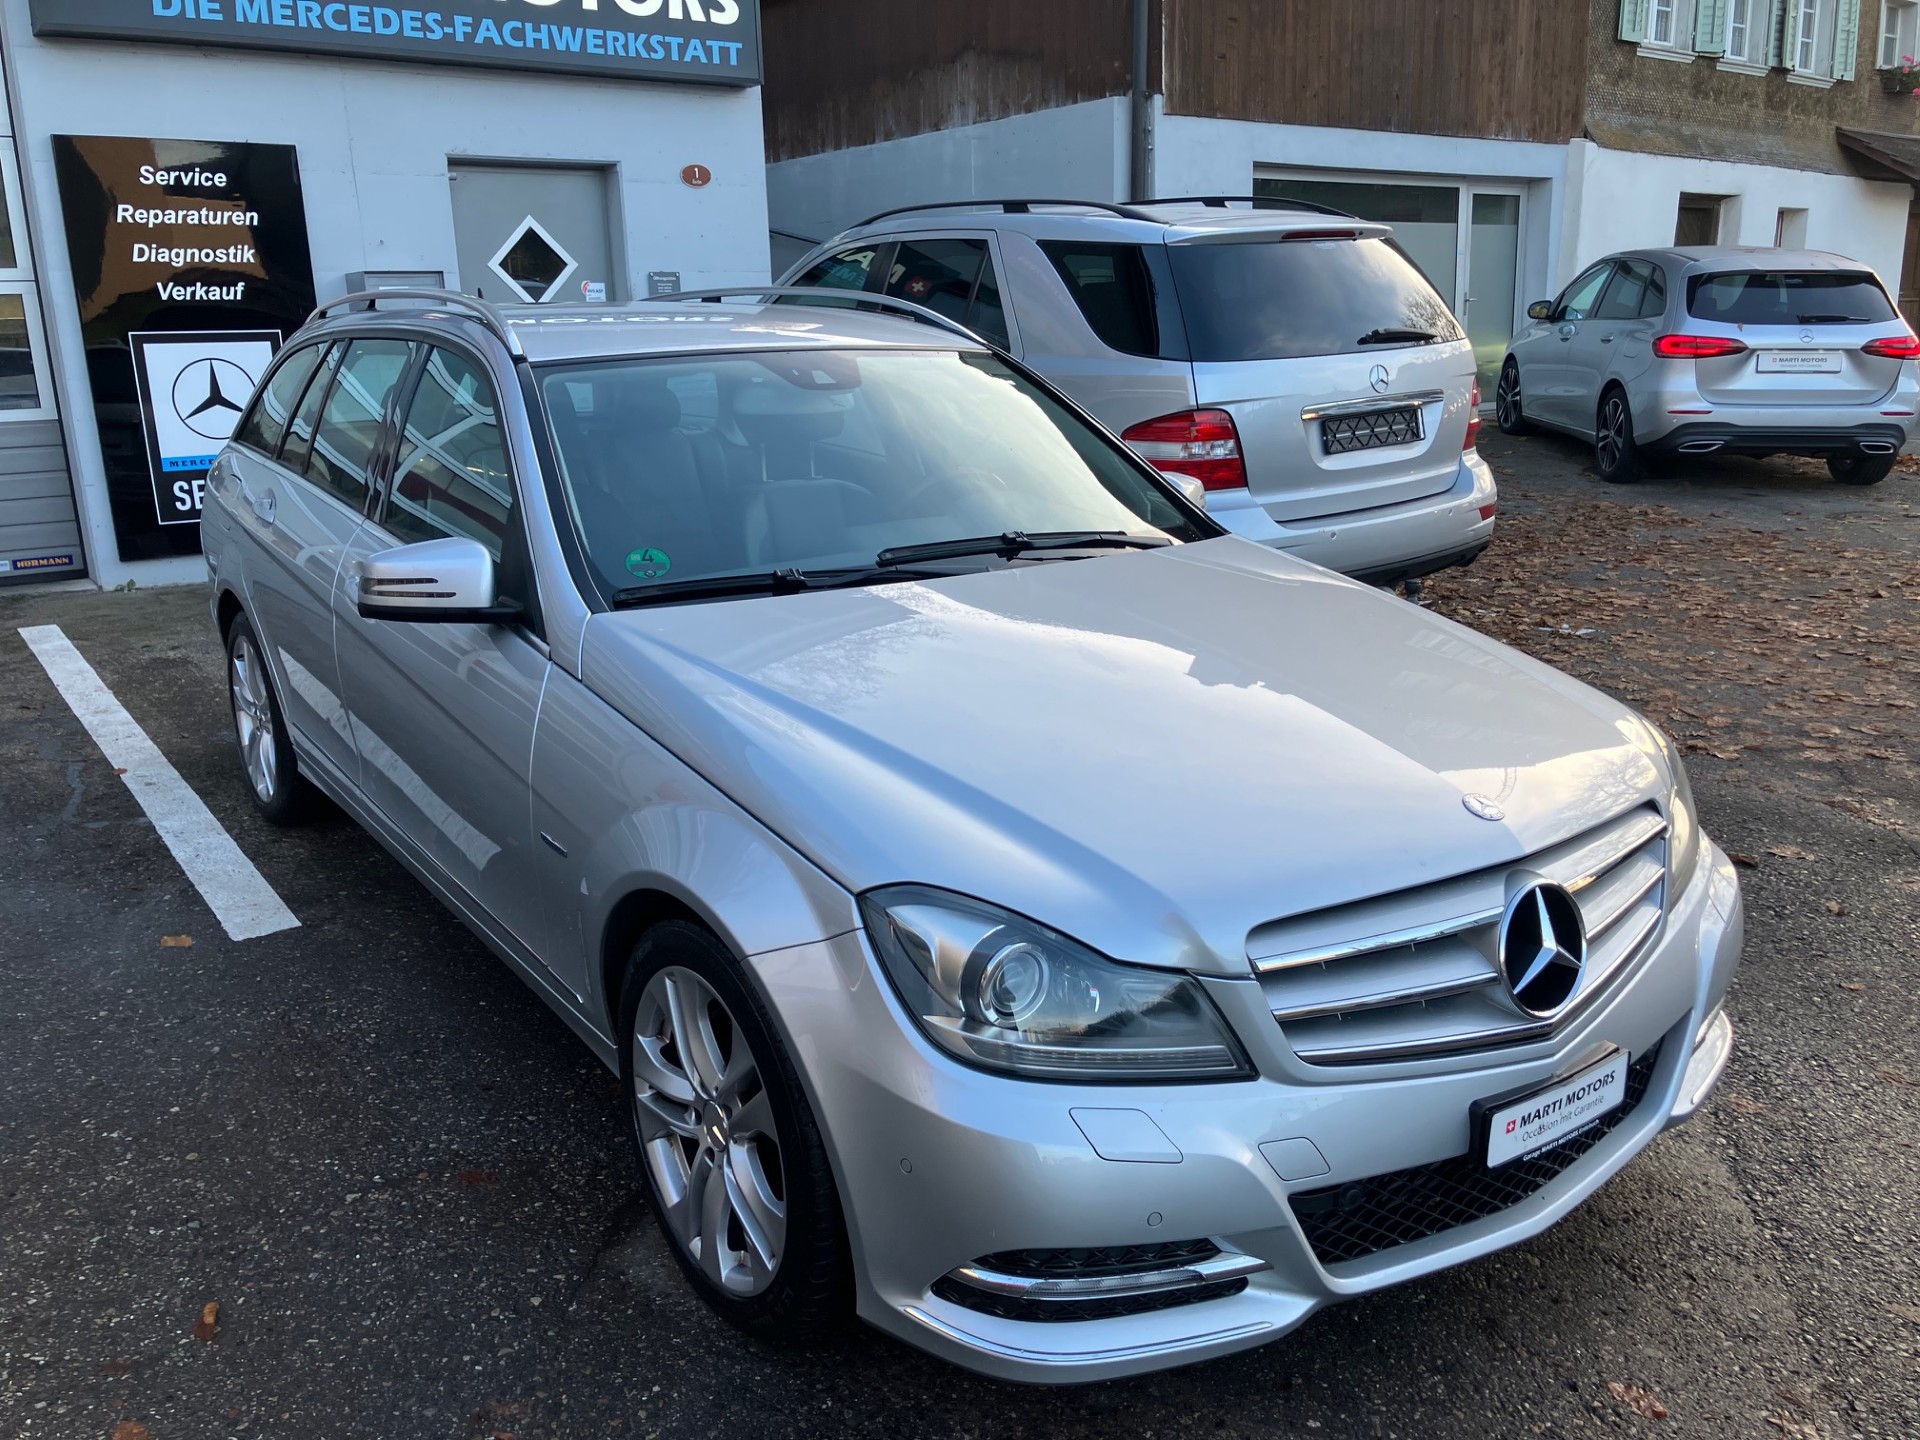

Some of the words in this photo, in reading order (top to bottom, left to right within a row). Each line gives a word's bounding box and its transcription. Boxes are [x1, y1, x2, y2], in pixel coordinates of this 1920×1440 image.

[153, 0, 224, 21] DIE
[235, 0, 743, 66] MERCEDES-FACHWERKSTATT
[139, 165, 228, 187] Service
[694, 167, 699, 178] 1
[116, 204, 259, 228] Reparaturen
[132, 243, 256, 267] Diagnostik
[157, 281, 246, 300] Verkauf
[169, 458, 215, 467] MERCE
[173, 479, 206, 511] SE
[641, 549, 655, 563] 4
[1519, 1098, 1563, 1128] MARTI
[1564, 1070, 1616, 1107] MOTORS
[1522, 1119, 1559, 1141] Occasion
[1559, 1111, 1573, 1126] mit
[1573, 1095, 1605, 1117] Garantie
[1523, 1149, 1541, 1161] Garage
[1541, 1140, 1558, 1153] MARTI
